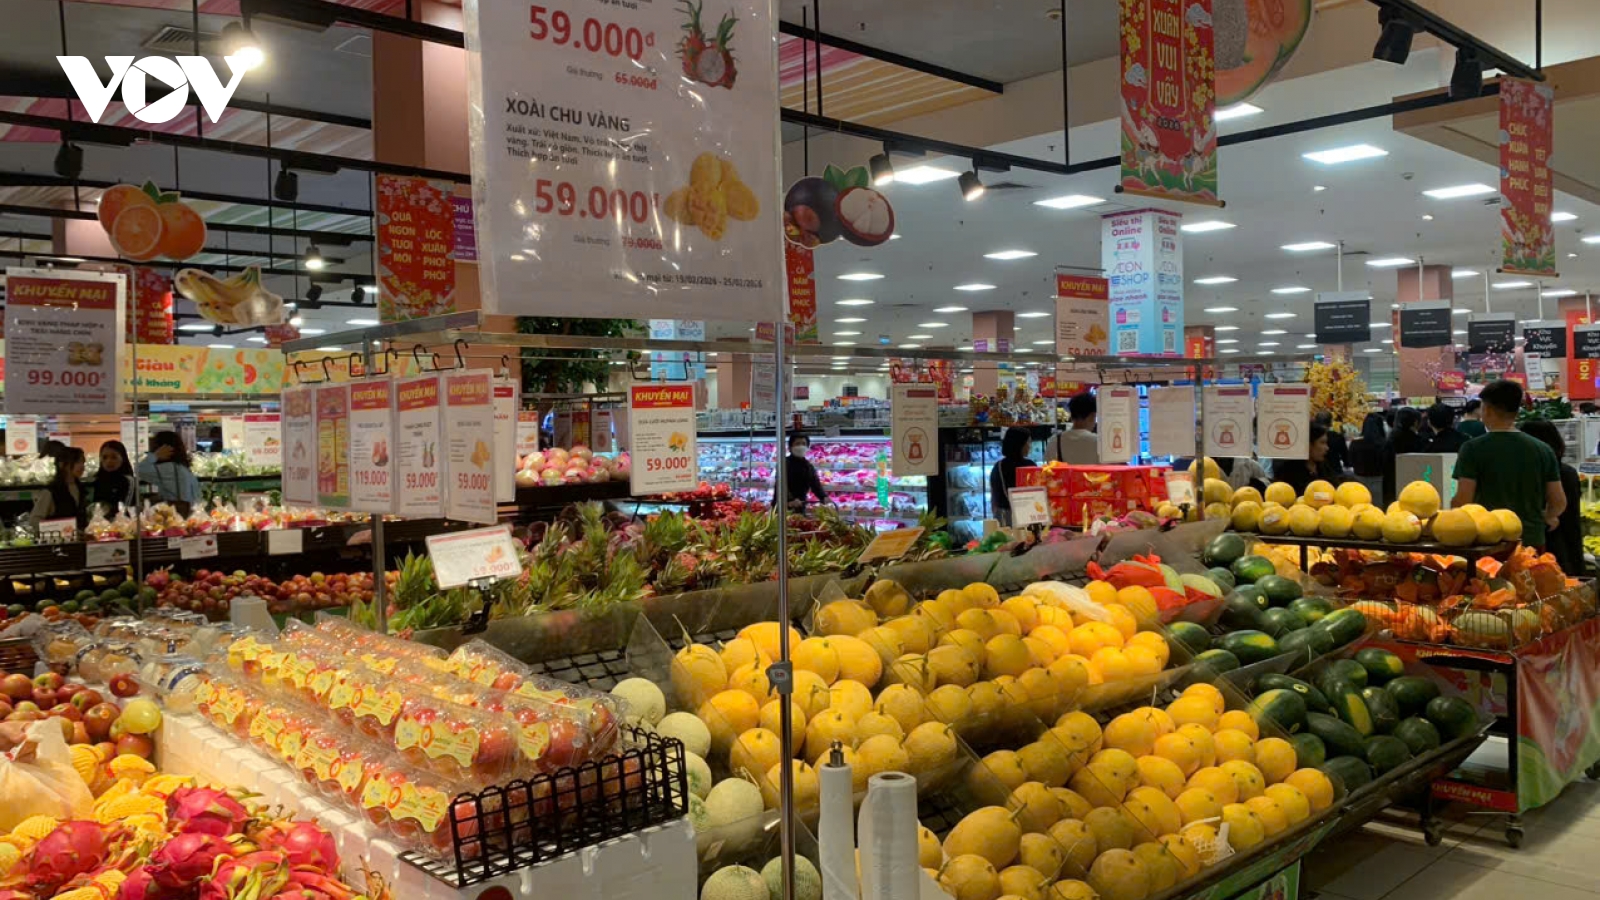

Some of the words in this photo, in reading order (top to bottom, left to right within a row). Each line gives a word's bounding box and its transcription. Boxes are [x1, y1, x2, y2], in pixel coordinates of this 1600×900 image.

[1153, 7, 1180, 39] XUÂN
[529, 4, 655, 60] 59.000đ
[1156, 42, 1177, 72] VUI
[505, 97, 546, 118] XOÀI
[549, 106, 583, 125] CHU
[587, 110, 631, 132] VÀNG
[506, 123, 526, 134] Xuất
[543, 129, 559, 141] Việt
[507, 147, 530, 158] Thích
[388, 224, 416, 236] NGON
[1111, 226, 1143, 237] Online
[13, 283, 77, 299] KHUYẾN
[635, 389, 671, 402] KHUYẾN
[672, 391, 688, 402] MẠI
